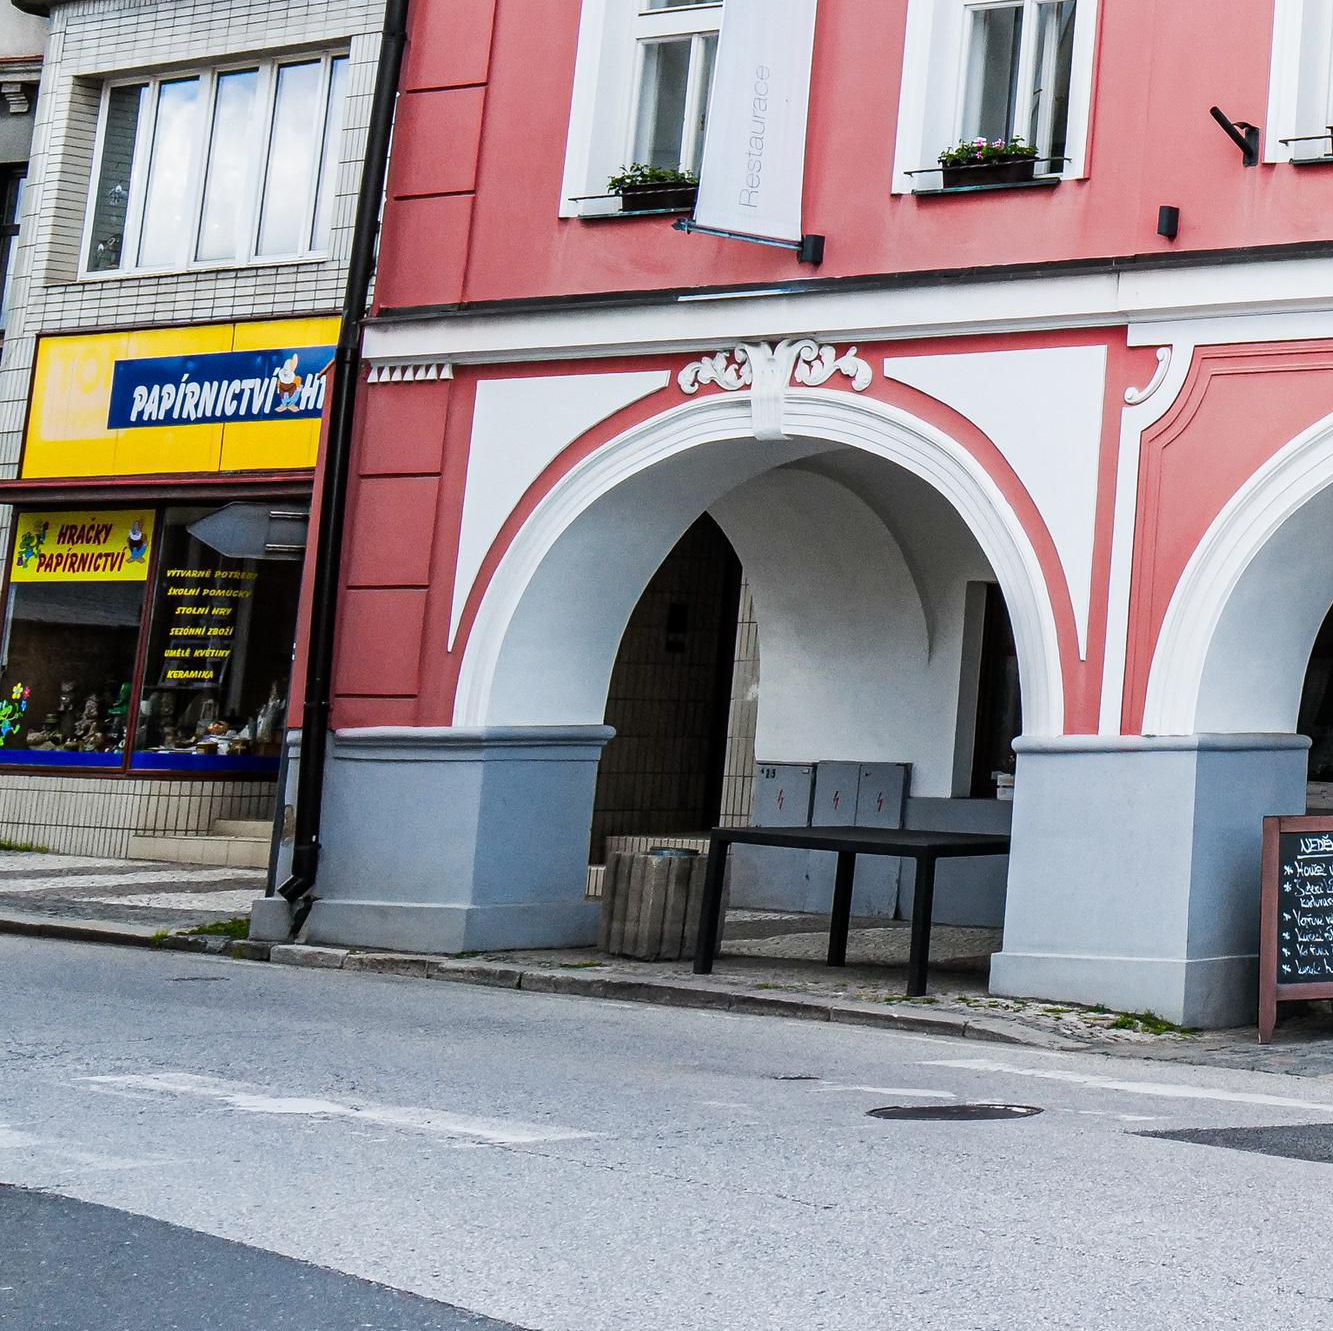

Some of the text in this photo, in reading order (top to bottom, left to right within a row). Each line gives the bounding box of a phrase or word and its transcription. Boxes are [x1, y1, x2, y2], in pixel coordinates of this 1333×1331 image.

[738, 65, 770, 208] Restaurace
[130, 367, 279, 422] PAPÍRNICTVÍ
[57, 517, 113, 546] HRAČKY
[36, 547, 127, 573] PAPÍRNICTVÍ
[166, 568, 211, 579] VÝTVARNÉ
[167, 587, 200, 596] ŠKOLNÍ
[175, 606, 232, 616] STOLNÍ HRY
[207, 626, 235, 636] ZBOŽÍ
[164, 648, 231, 658] UMĚLÉ KVĚTINY
[167, 670, 214, 679] KERAMIKA
